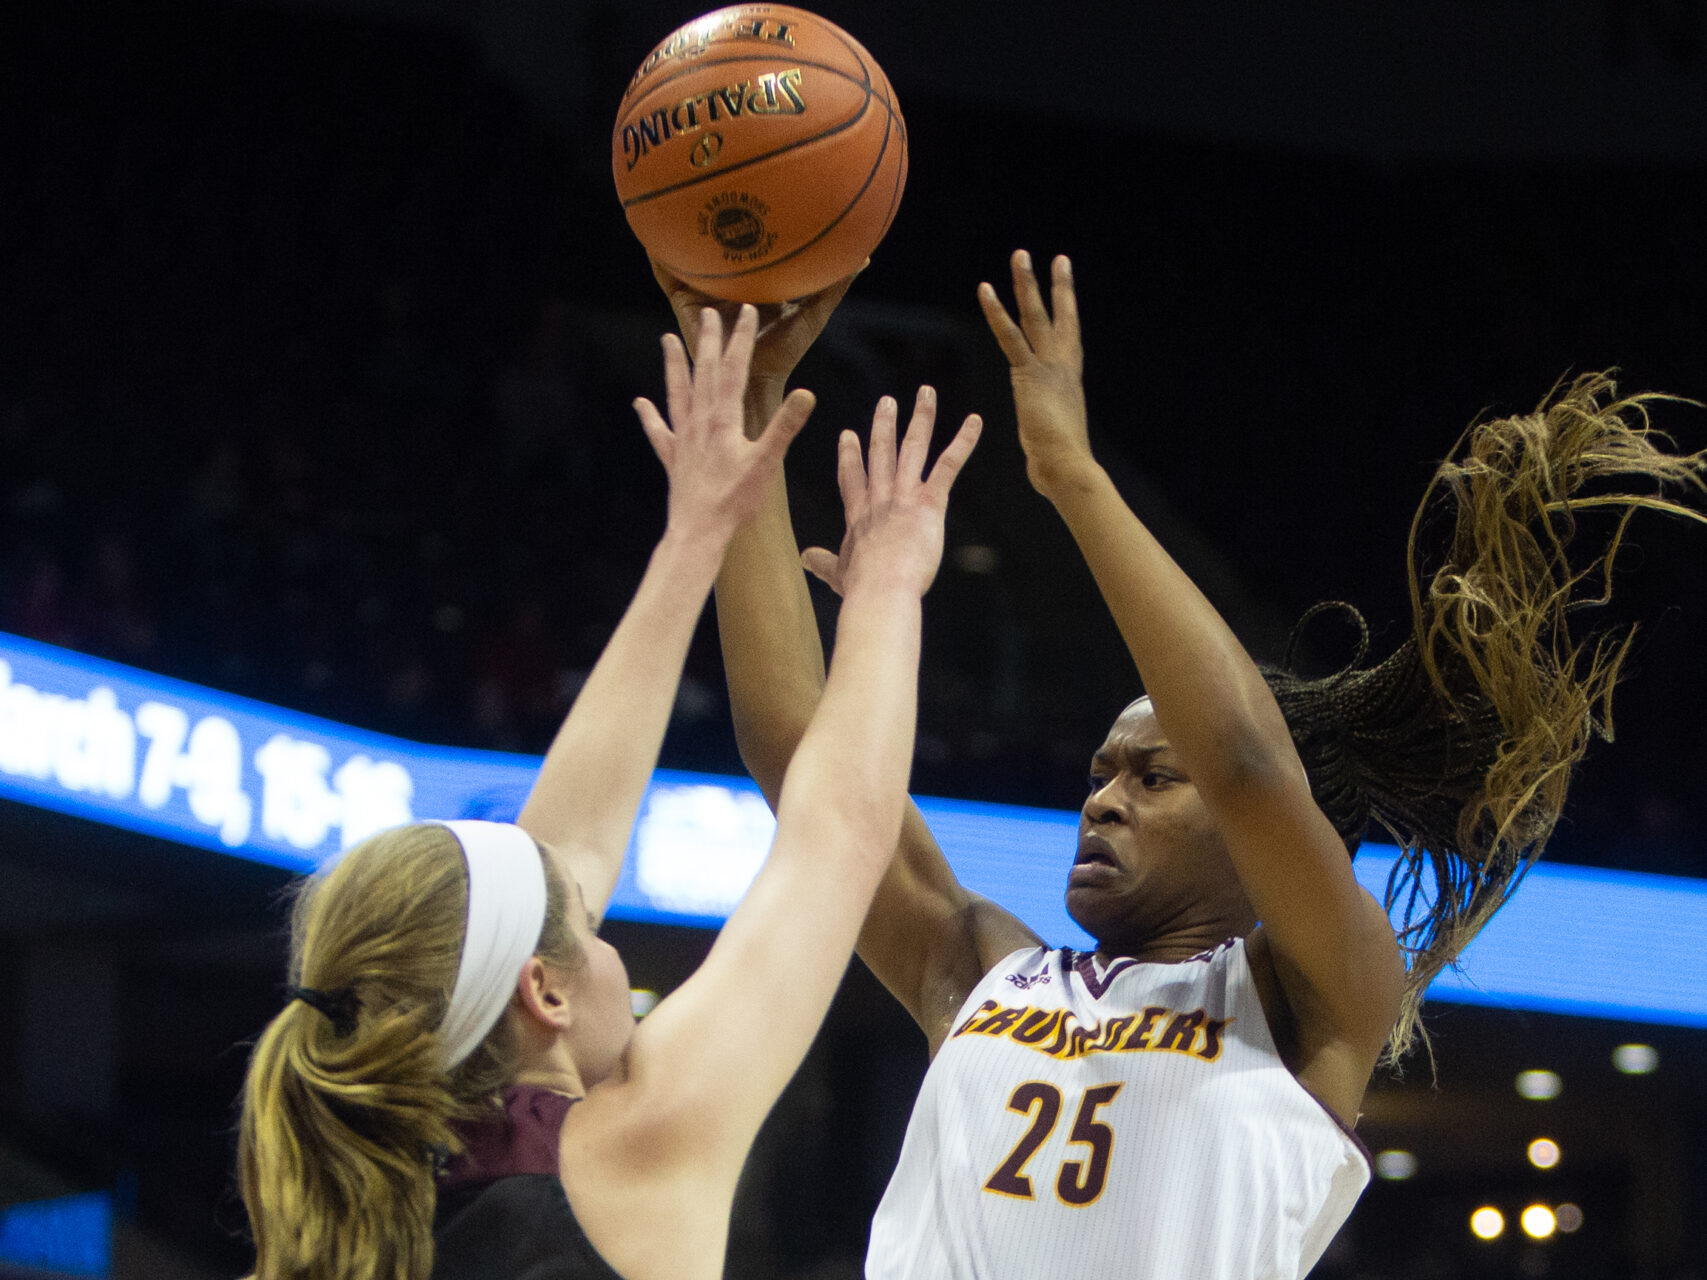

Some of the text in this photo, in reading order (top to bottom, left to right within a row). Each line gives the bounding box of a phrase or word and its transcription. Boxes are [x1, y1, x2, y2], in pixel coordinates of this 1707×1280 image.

[622, 67, 806, 173] SPALDING
[0, 657, 136, 799] arch
[982, 1079, 1126, 1209] 25
